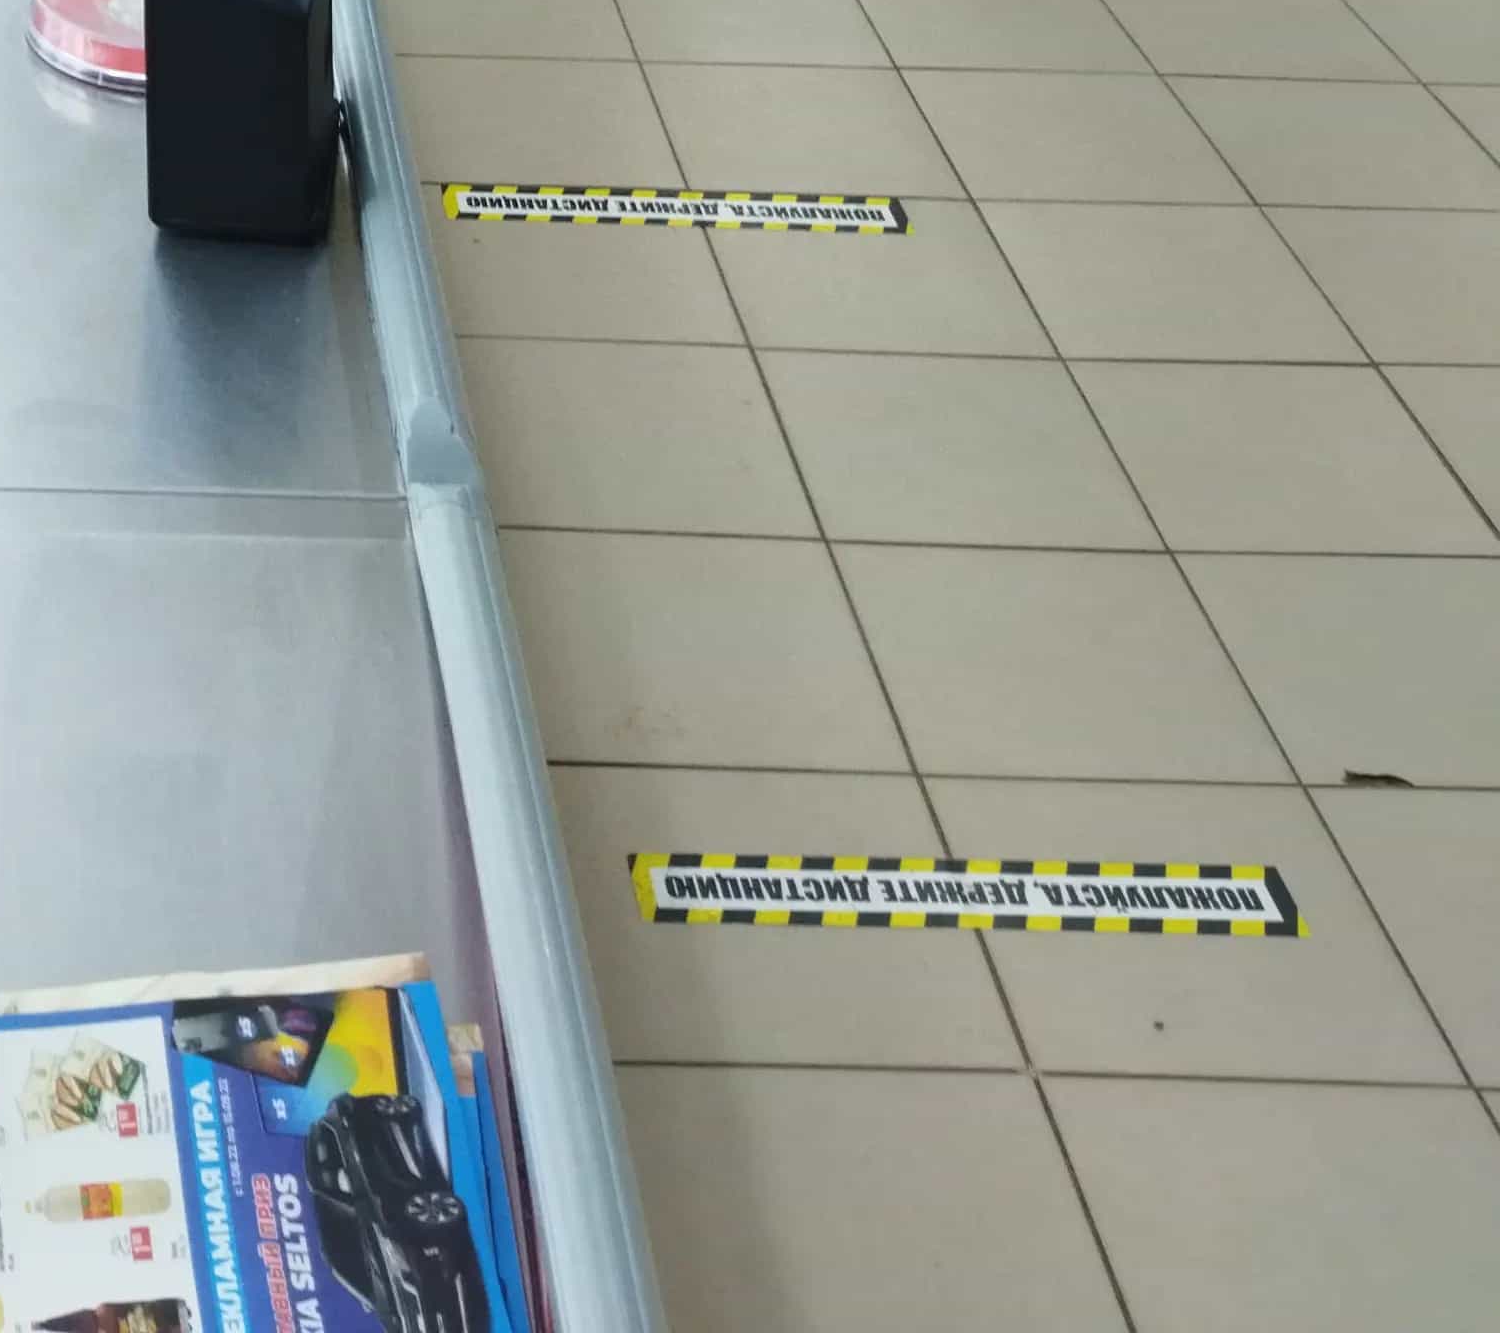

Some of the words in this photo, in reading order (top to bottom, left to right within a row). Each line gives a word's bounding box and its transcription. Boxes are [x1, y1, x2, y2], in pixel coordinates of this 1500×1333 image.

[466, 196, 609, 212] ДИСТАНЦИЮ
[619, 201, 718, 215] ДЕРЖИТЕ
[729, 204, 886, 221] ПОЖАЛУЙСТА,
[664, 874, 871, 902] ДИСТАНЦИЮ
[880, 879, 1028, 905] ДЕРЖИТЕ
[1033, 878, 1265, 913] ПОЖАЛУЙСТА,
[190, 1079, 220, 1163] ИГРА
[251, 1172, 278, 1240] ПРИЗ
[273, 1172, 316, 1292] SELTOS
